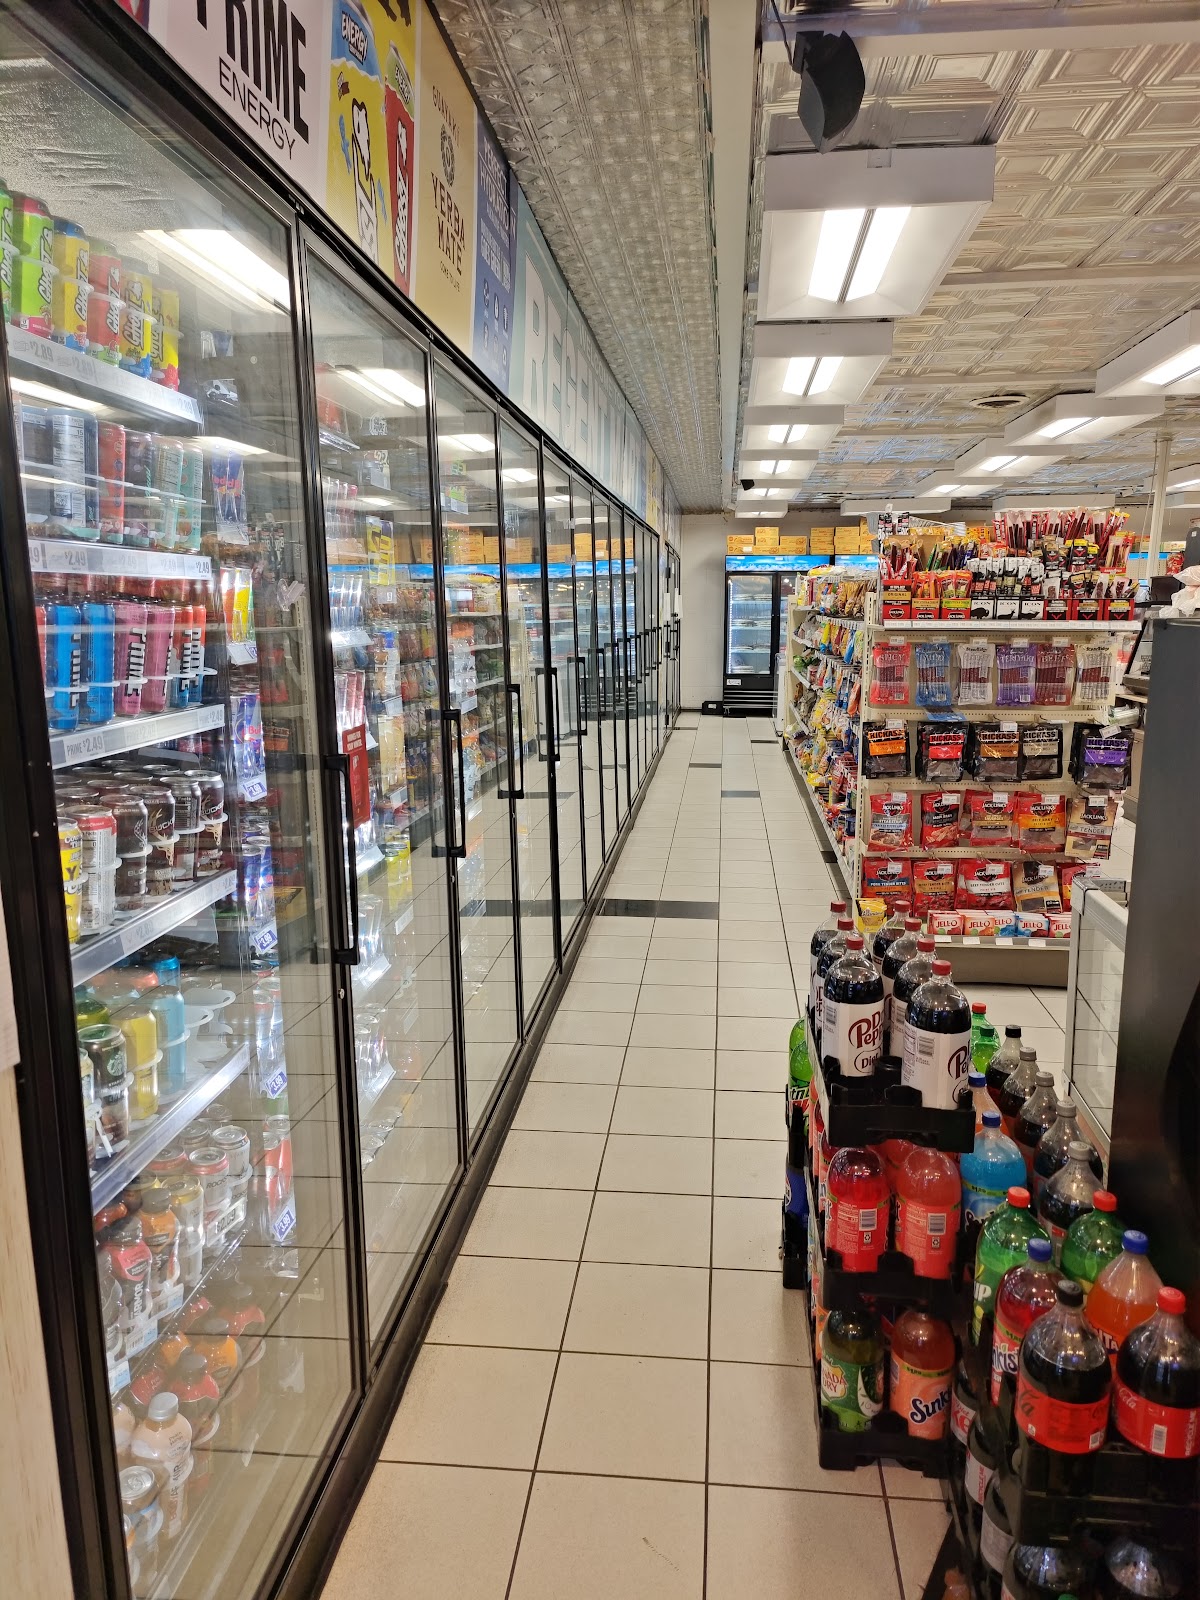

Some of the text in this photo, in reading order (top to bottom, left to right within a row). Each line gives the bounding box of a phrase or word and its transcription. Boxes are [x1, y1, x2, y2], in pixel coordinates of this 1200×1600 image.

[219, 56, 296, 160] ENERGY
[484, 136, 507, 201] PERFECT
[431, 172, 466, 252] YERBA
[437, 216, 462, 276] MATE
[578, 318, 614, 404] WELCOME
[522, 250, 641, 511] REGENT MART
[65, 550, 86, 567] $2.49
[196, 561, 210, 574] $2.49
[879, 653, 905, 661] SPICY
[209, 709, 223, 723] $2.49
[869, 729, 904, 739] KICKASS
[930, 734, 961, 742] KICKASS
[981, 732, 1017, 740] KICKASS
[1024, 731, 1056, 739] KICKASS
[66, 735, 103, 755] PRIME $2.49
[1089, 739, 1125, 747] KICKASS
[1025, 885, 1049, 893] TENDER
[936, 920, 958, 928] JELL-O
[969, 920, 991, 929] JELL-O
[1022, 921, 1043, 929] JELL-O
[908, 1387, 951, 1424] Sunk
